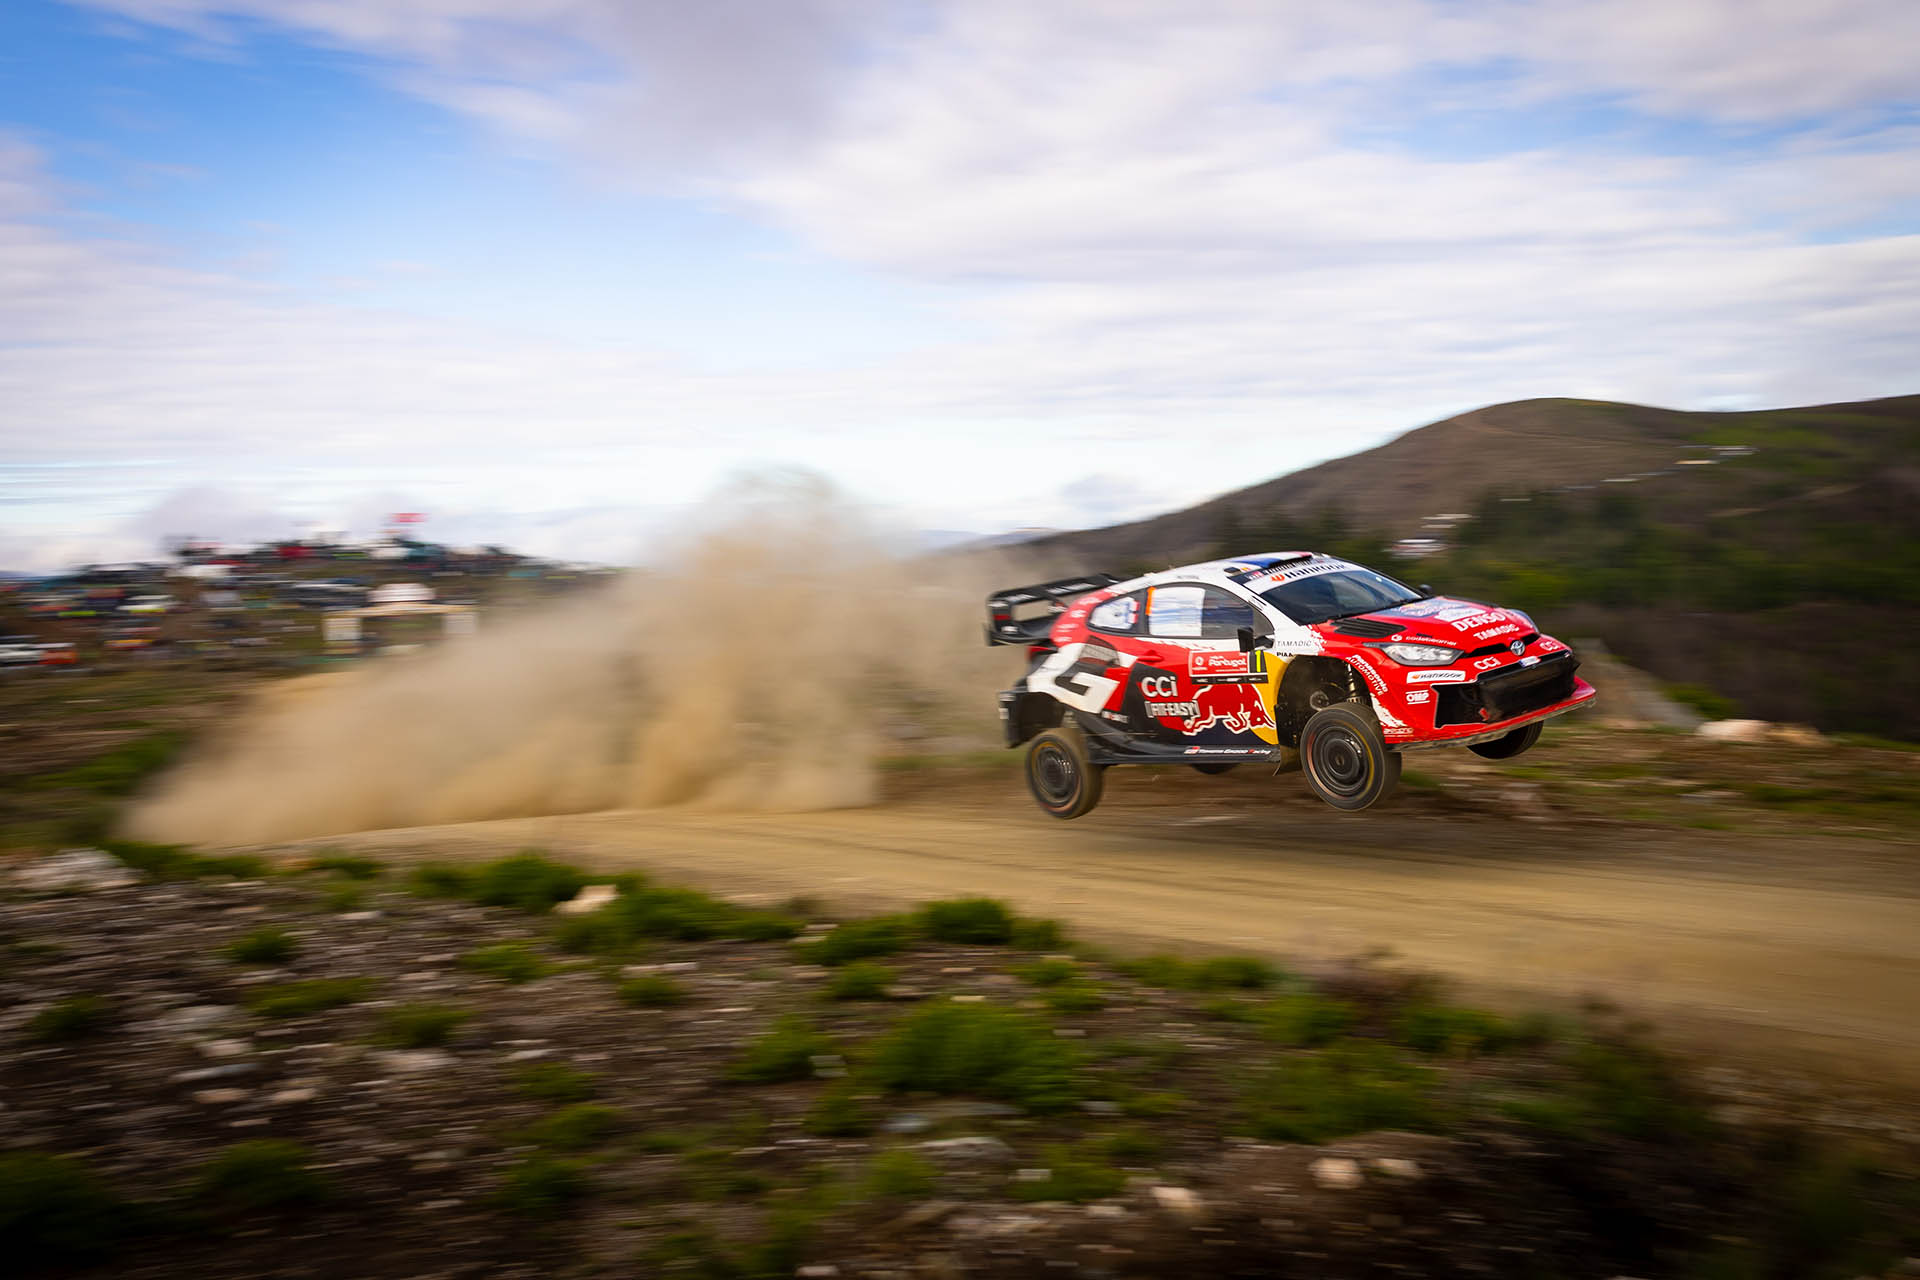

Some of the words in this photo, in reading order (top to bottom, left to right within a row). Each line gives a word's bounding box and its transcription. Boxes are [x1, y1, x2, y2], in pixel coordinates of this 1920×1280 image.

[1451, 611, 1507, 632] DENSO
[1473, 623, 1520, 641] TAMADIC
[1208, 657, 1248, 668] Portugal
[1255, 649, 1262, 673] 1
[1141, 675, 1178, 697] CCi
[1345, 656, 1385, 696] AUTOMOTIVE
